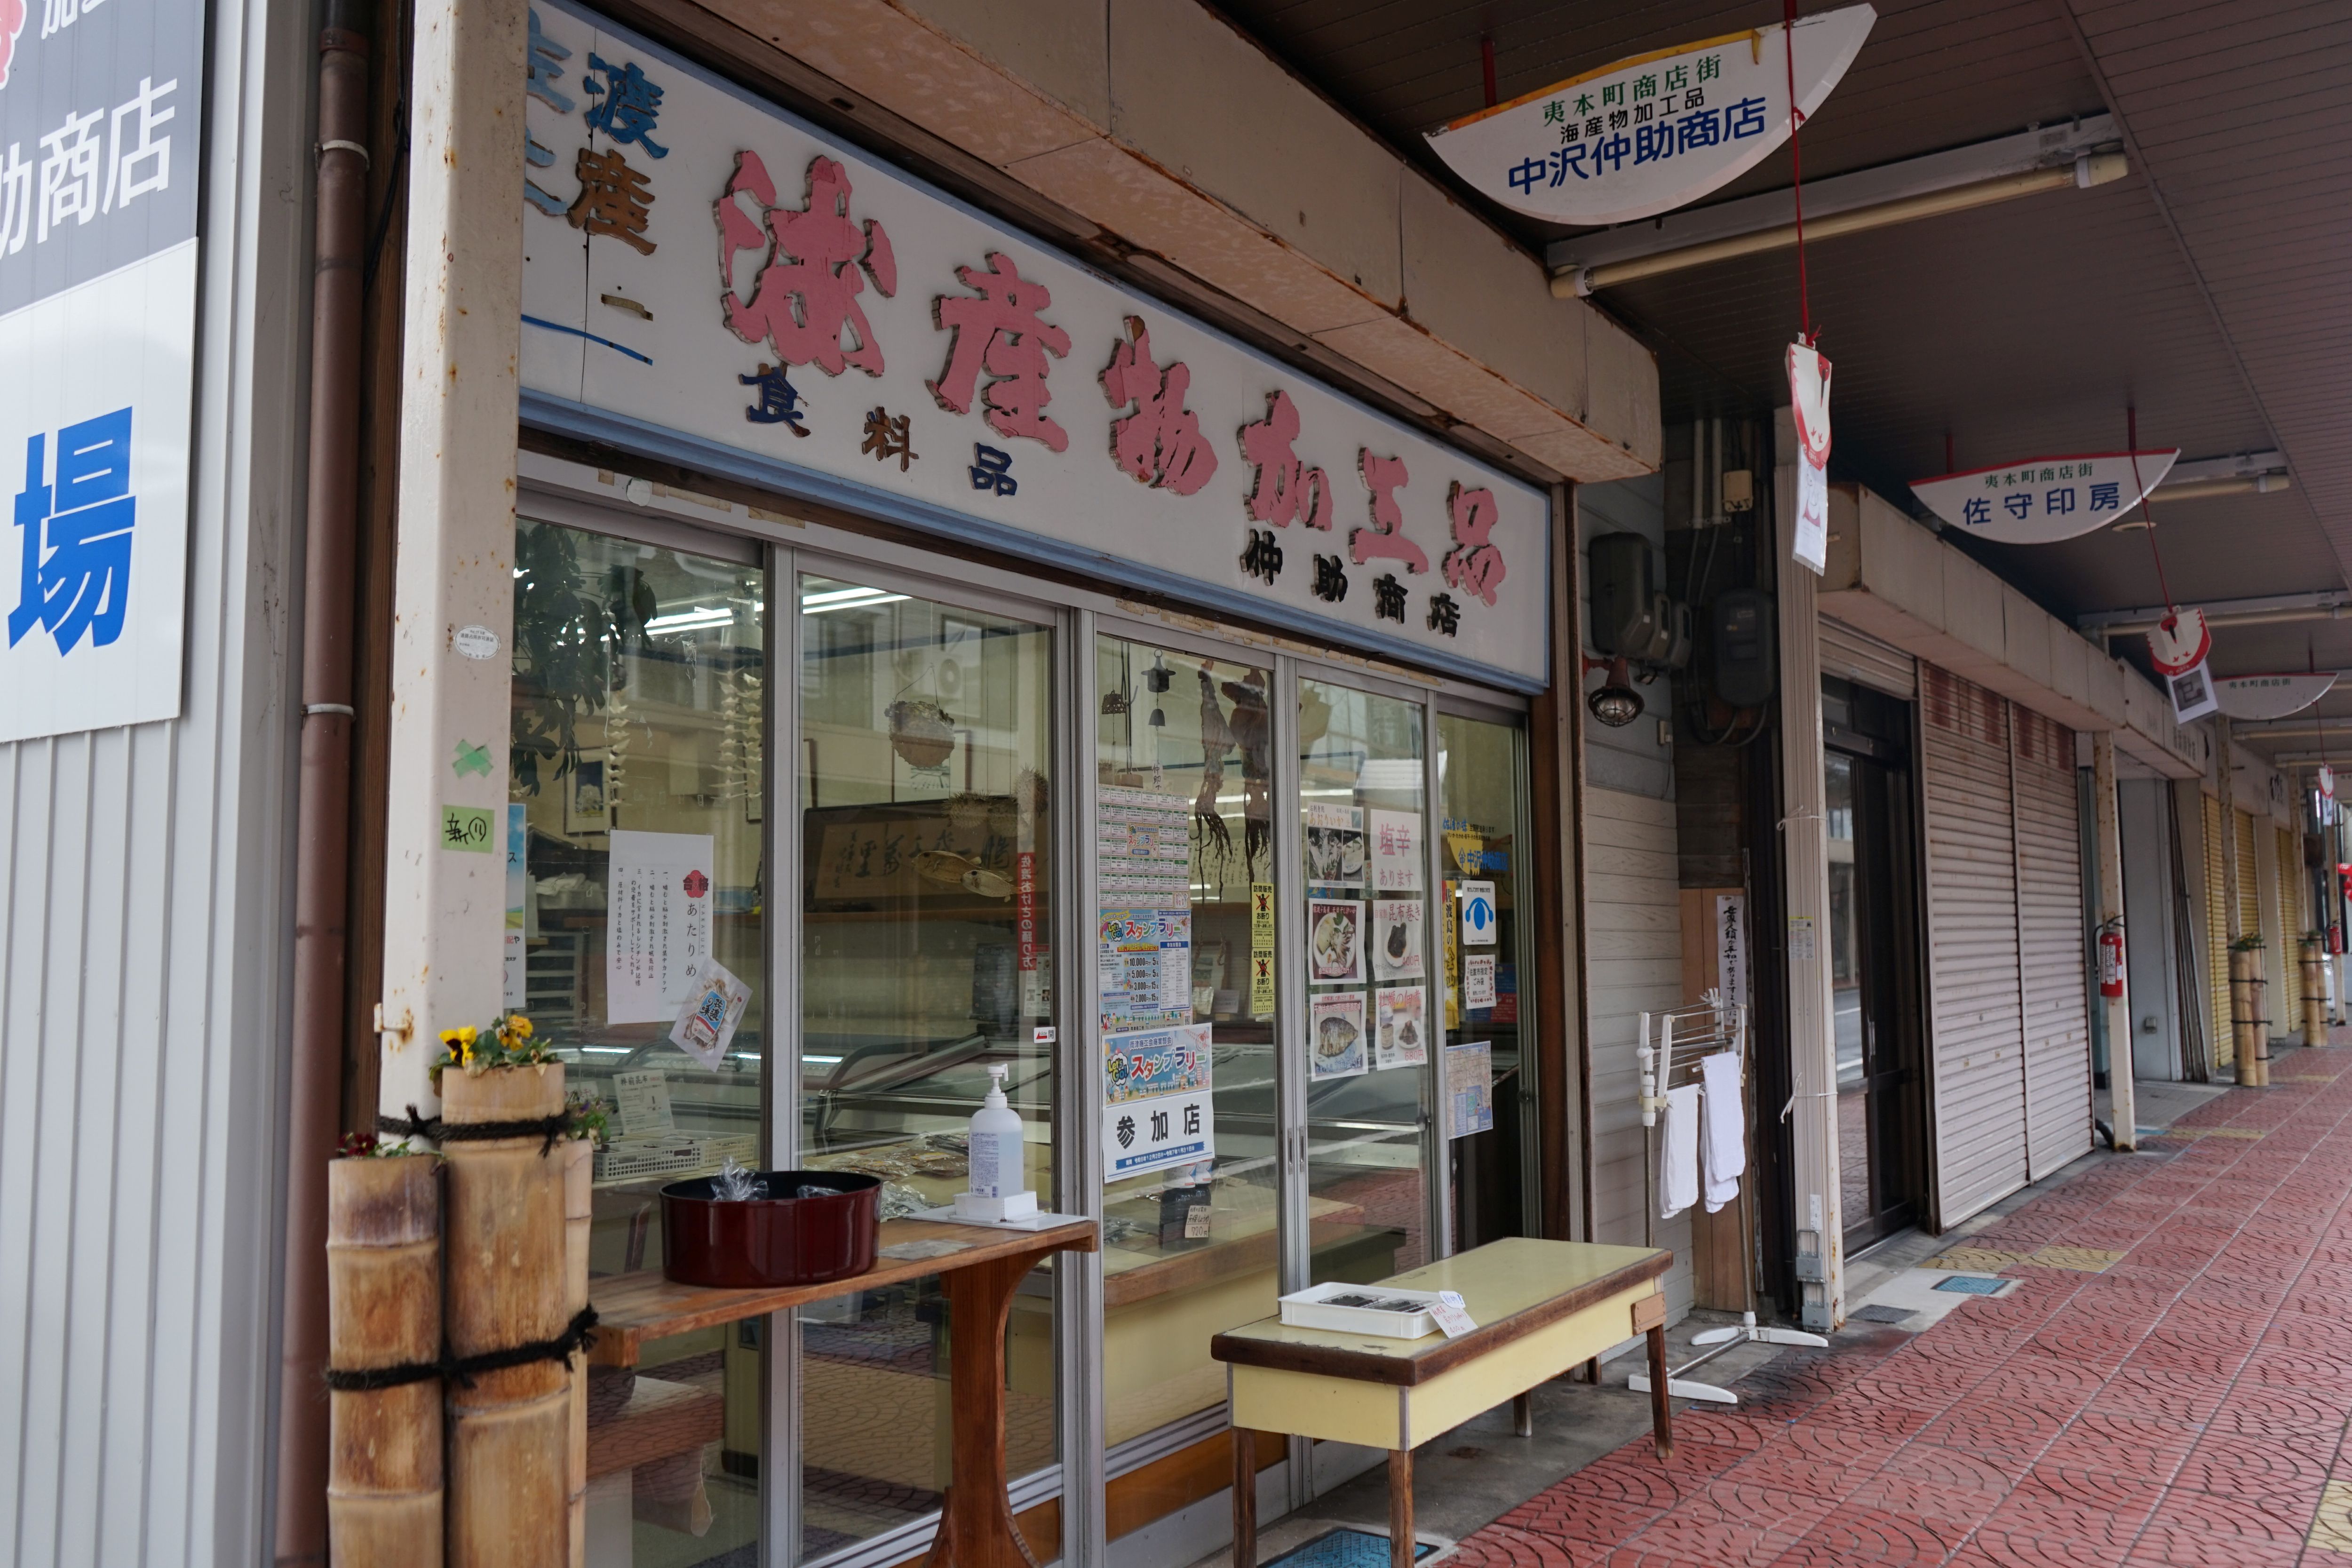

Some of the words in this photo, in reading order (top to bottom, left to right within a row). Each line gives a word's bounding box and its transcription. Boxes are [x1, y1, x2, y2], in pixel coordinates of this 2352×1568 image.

[1542, 53, 1722, 127] 夷本町商店街
[1560, 87, 1705, 144] 海産物加工品
[1509, 96, 1767, 195] 中沢仲助商店
[713, 150, 1507, 607] 海産物加工品
[739, 362, 1018, 497] 食料品
[1985, 462, 2094, 489] 夷本町商店街
[1963, 481, 2121, 525] 佐守印房
[8, 406, 136, 658] 場
[1240, 528, 1462, 637] 仲助商店
[2229, 677, 2291, 689] 夷本町商店街
[1379, 823, 1410, 857] 塩辛
[1380, 868, 1414, 888] あります
[1125, 917, 1182, 940] スタンプラリー
[1389, 903, 1420, 922] 昆布巻き
[686, 903, 698, 977] あたりめ
[1445, 888, 1455, 988] 佐渡島の金山
[1048, 1030, 1054, 1039] 開
[1129, 1036, 1173, 1050] 両津商工会商業部会
[1107, 1058, 1124, 1074] Let's
[1112, 1065, 1128, 1082] Go!
[1130, 1044, 1206, 1082] スタンプラリー
[1405, 1049, 1424, 1062] 680円
[1116, 1103, 1200, 1150] 参加店
